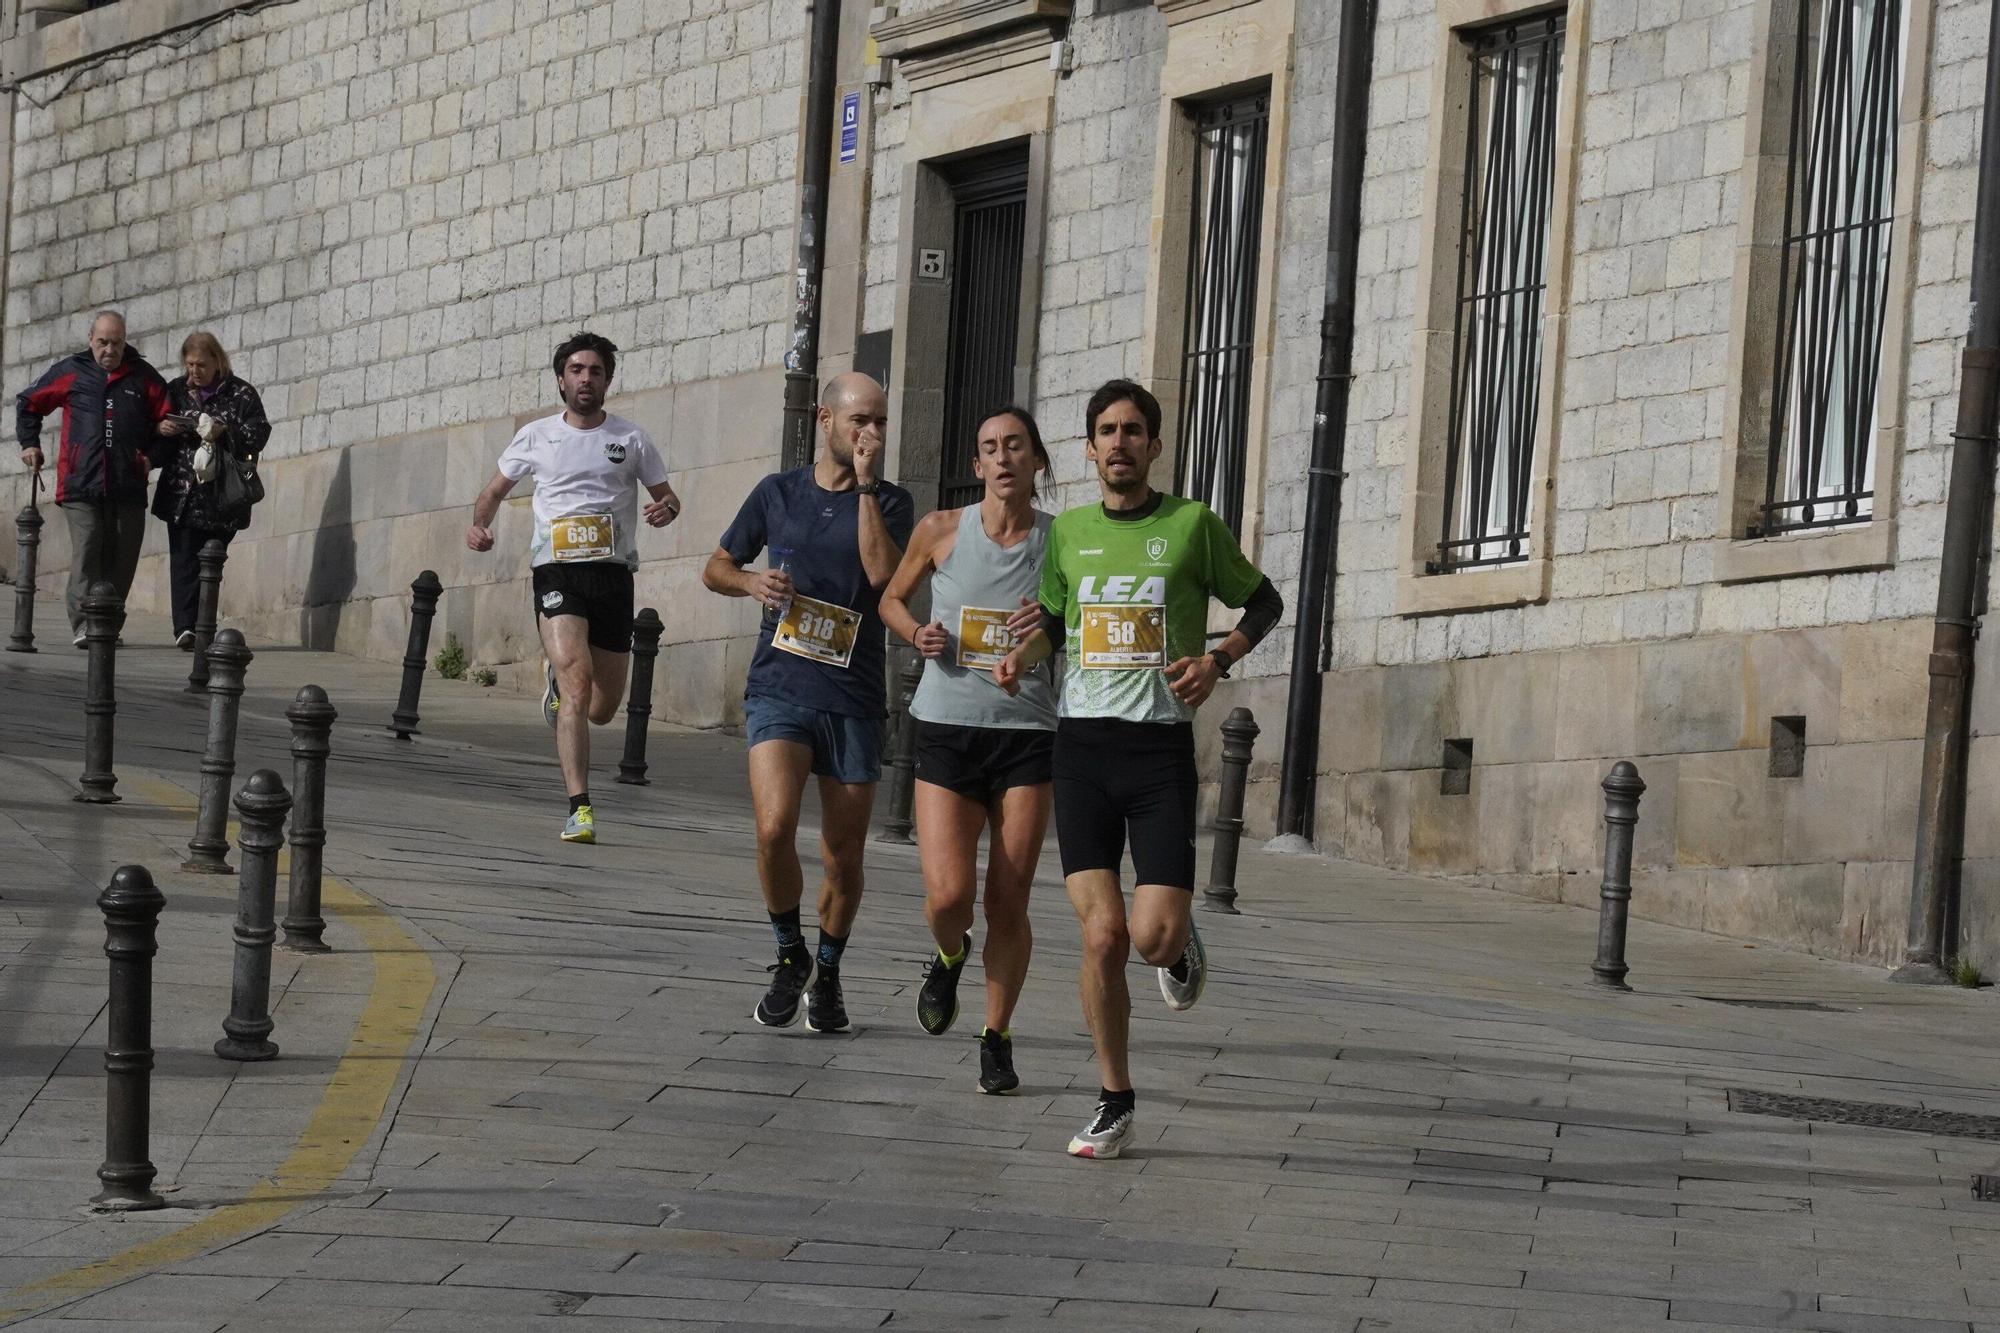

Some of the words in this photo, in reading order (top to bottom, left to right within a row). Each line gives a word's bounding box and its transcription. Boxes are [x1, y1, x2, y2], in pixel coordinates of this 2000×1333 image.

[924, 253, 940, 273] 3
[567, 525, 598, 544] 636
[1077, 575, 1166, 604] LEA
[798, 611, 835, 640] 318
[1107, 621, 1136, 645] 58
